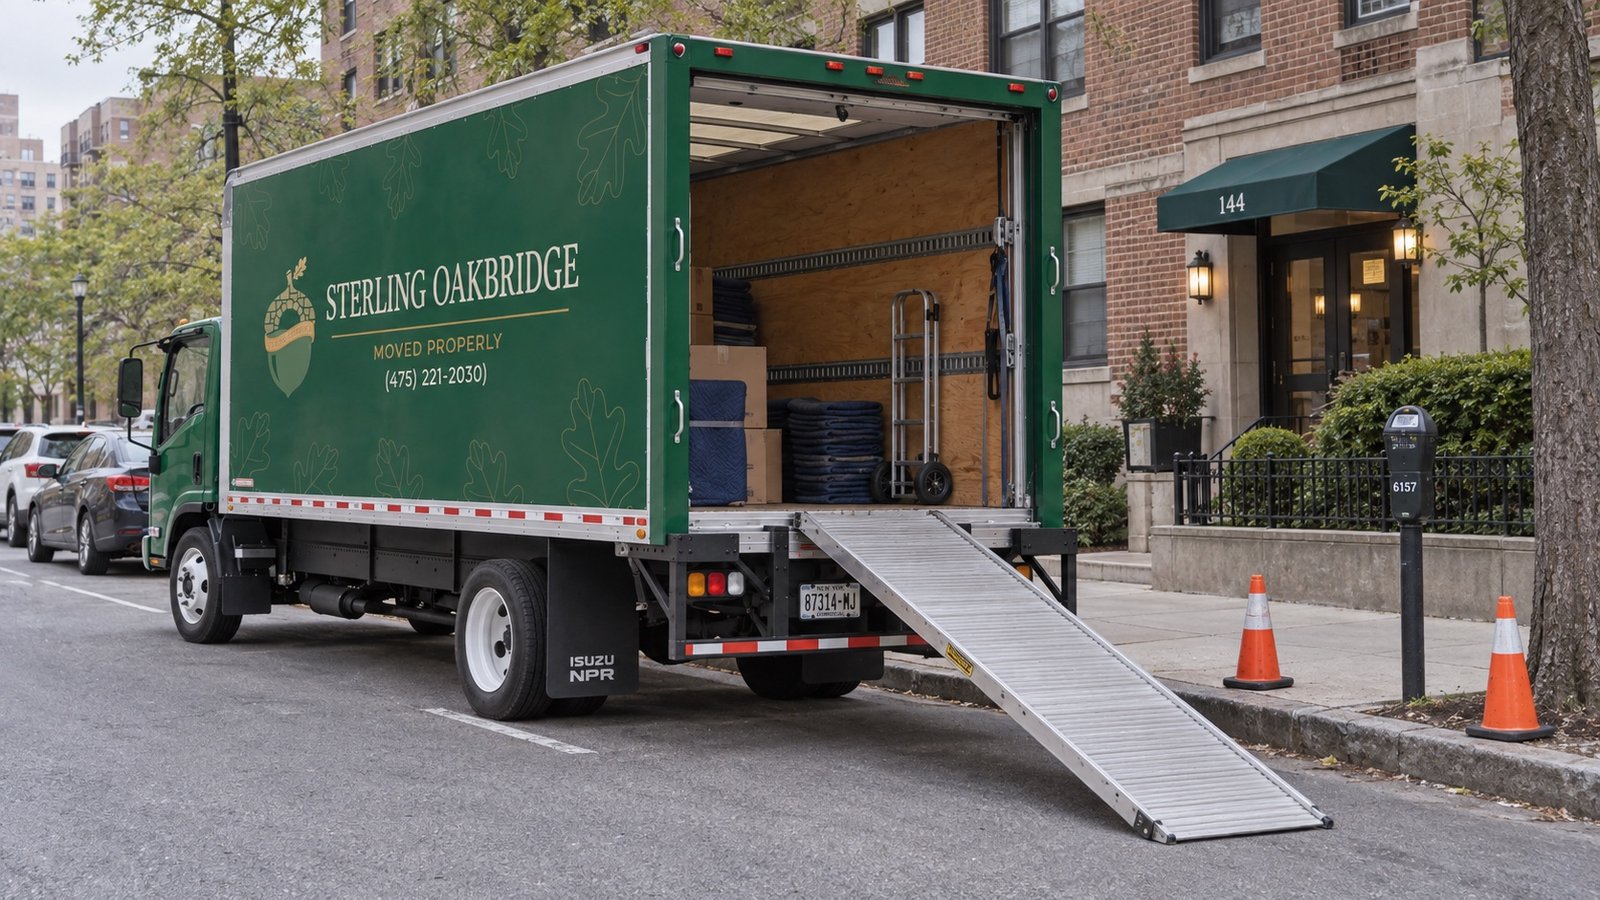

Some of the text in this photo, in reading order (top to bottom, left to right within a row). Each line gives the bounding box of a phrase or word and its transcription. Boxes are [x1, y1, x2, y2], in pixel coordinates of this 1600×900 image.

[1219, 192, 1246, 215] 144
[326, 242, 579, 321] STERLING OAKBRIDGE
[373, 332, 503, 361] MOVED PROPERLY
[385, 362, 488, 393] (475) 221-2030)
[1393, 481, 1417, 493] 6157
[570, 654, 615, 668] ISUZU
[570, 668, 615, 683] NPR
